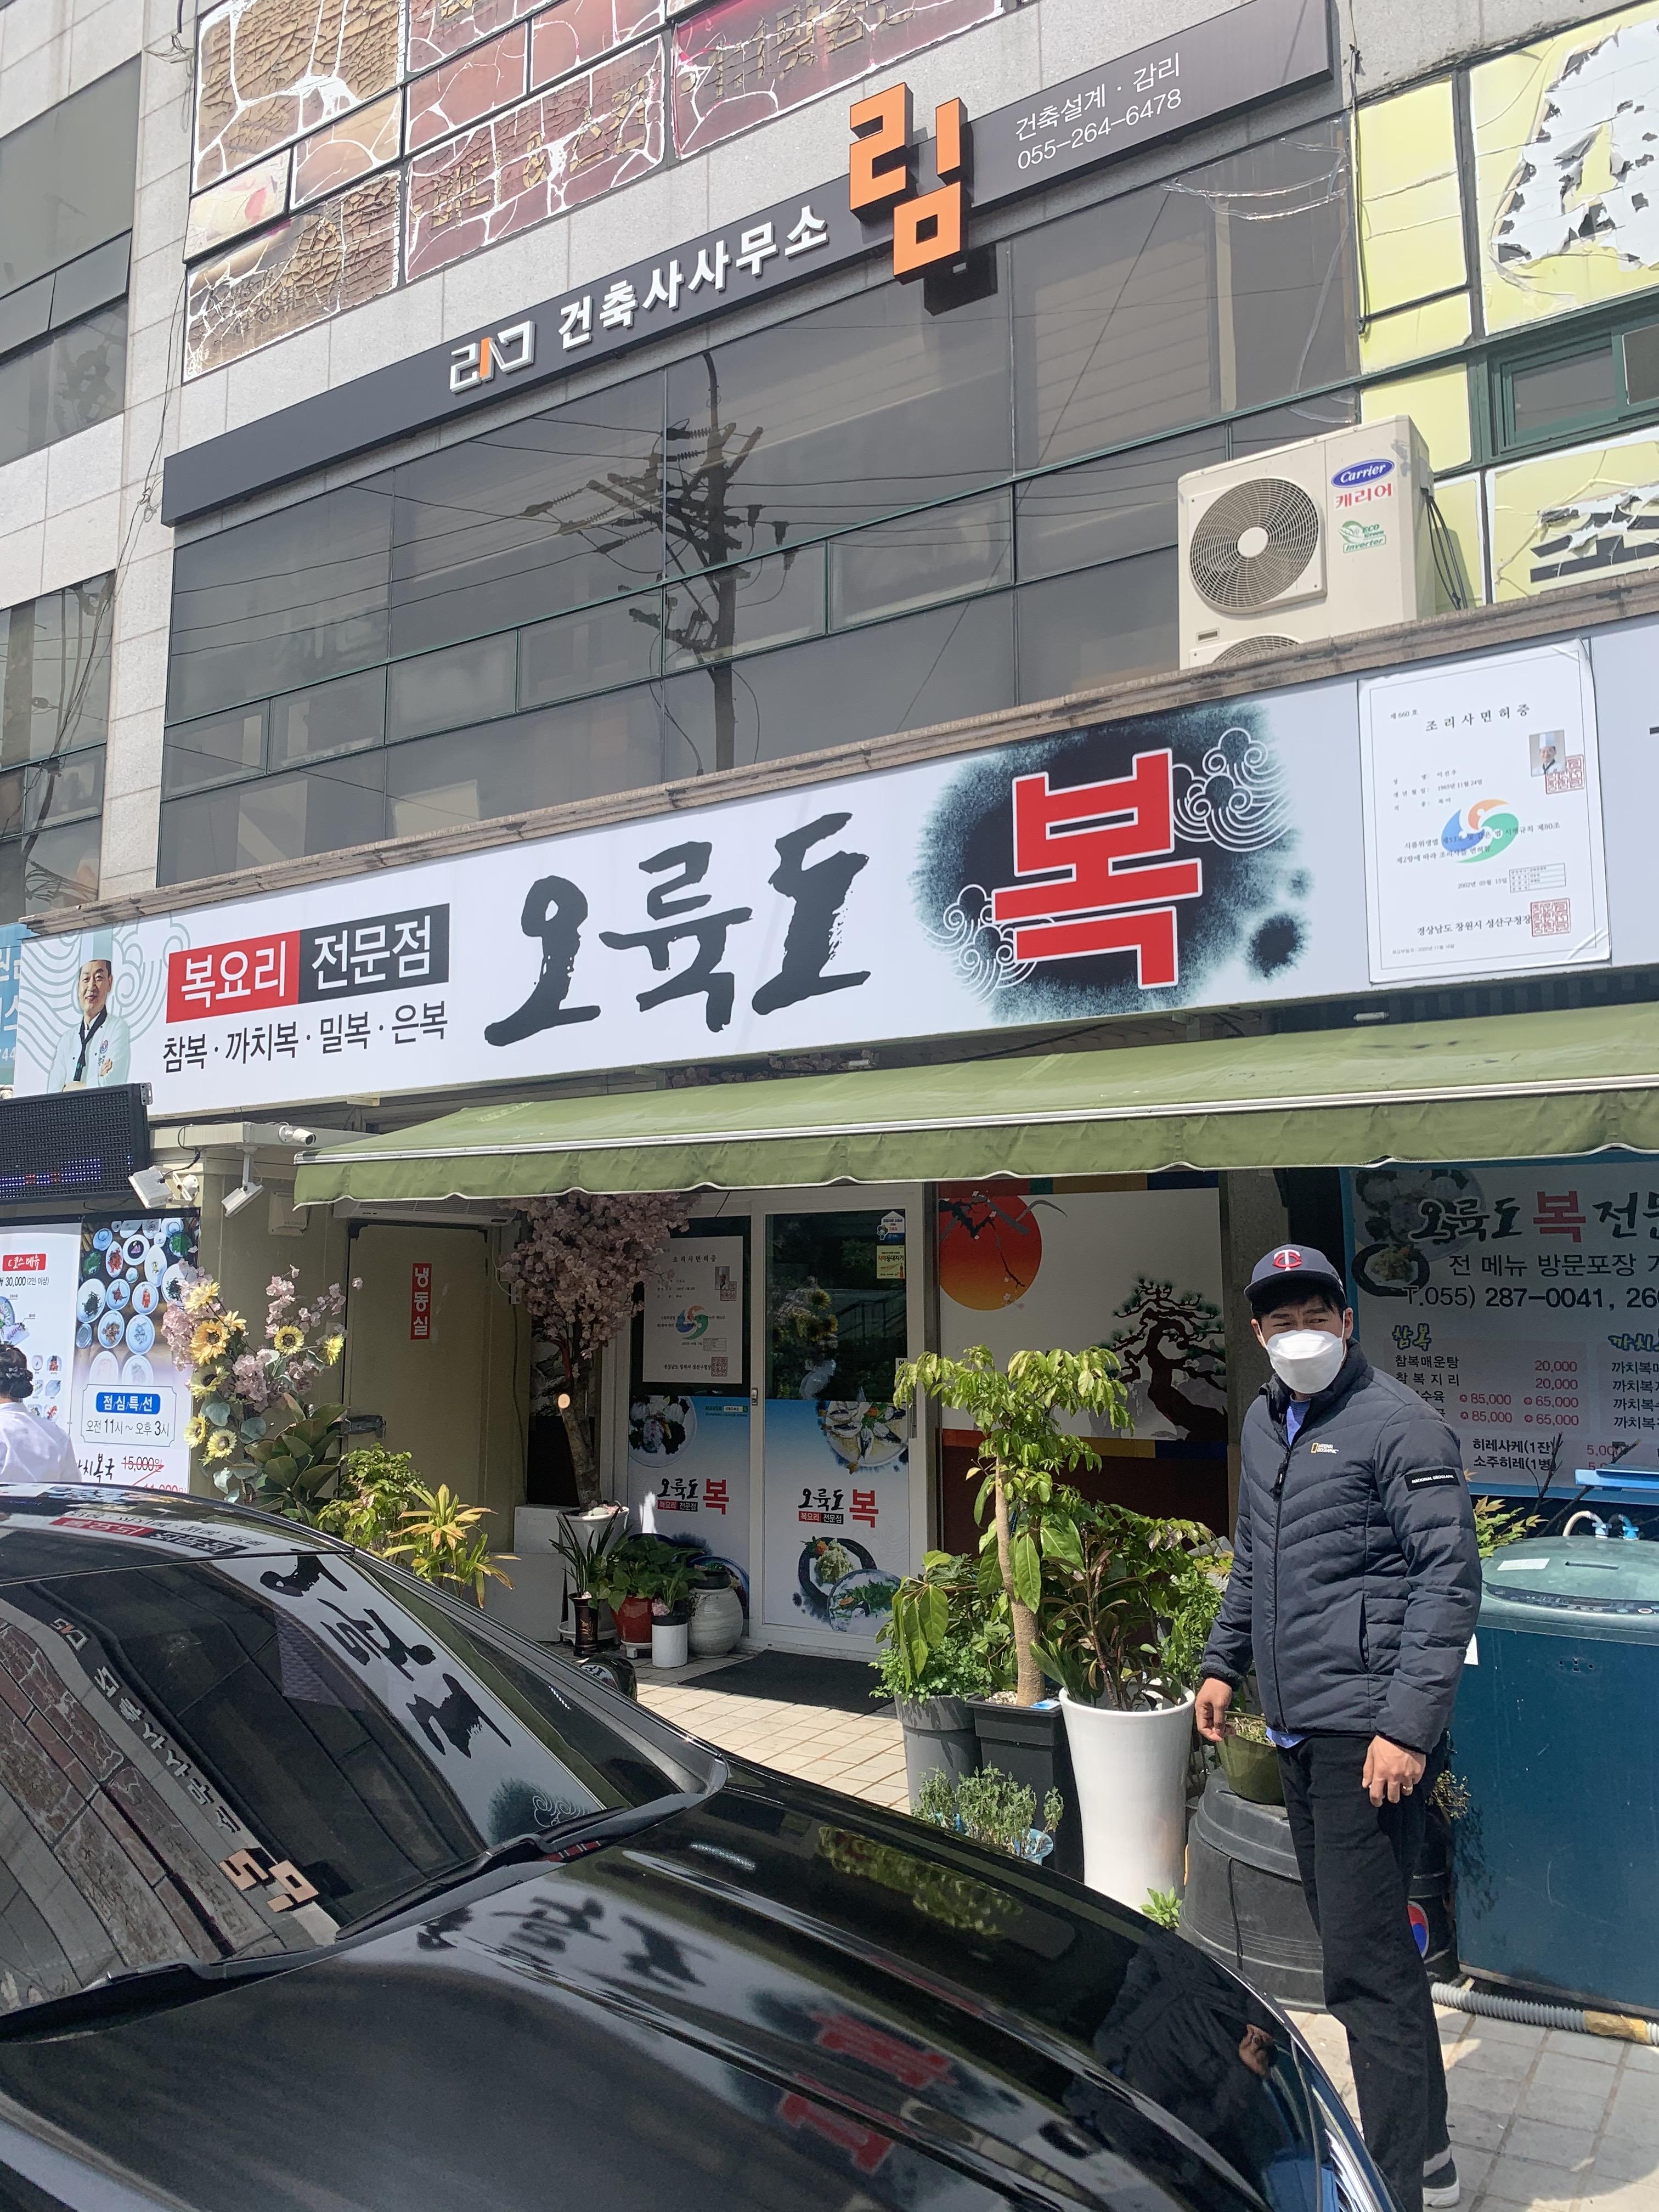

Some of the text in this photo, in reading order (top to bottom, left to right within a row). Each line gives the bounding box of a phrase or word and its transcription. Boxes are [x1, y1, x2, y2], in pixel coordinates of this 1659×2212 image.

[1015, 52, 1180, 142] 건축설계 감리
[1017, 89, 1182, 170] 055-264-6478
[850, 82, 964, 279] 림
[557, 205, 830, 352] 건축사사무소
[1340, 464, 1386, 483] Carrier
[1335, 483, 1392, 509] 캐리어
[1362, 523, 1380, 533] ECO
[1346, 538, 1384, 551] Inverter
[990, 747, 1203, 990] 복
[483, 811, 872, 1048] 오륙도
[180, 915, 431, 1008] 복요리 전문점
[162, 1001, 448, 1074] 참복 까치복 밀복 은복
[1408, 1197, 1523, 1244] 오륙도
[1533, 1190, 1587, 1243] 복
[1449, 1254, 1471, 1277] 전
[1482, 1254, 1528, 1277] 메뉴
[1538, 1253, 1637, 1277] 방문포장
[5, 1277, 26, 1287] 30,000
[1626, 1288, 1659, 1309] 26
[1607, 1329, 1659, 1352] 까치
[1395, 1355, 1577, 1372] 참복매운탕 20,000
[1536, 1378, 1578, 1390] 20,000
[86, 1420, 101, 1434] 오전
[104, 1419, 123, 1435] 11시
[136, 1422, 152, 1436] 오후
[154, 1420, 170, 1437] 3시
[657, 1478, 729, 1515] 오륙도 복
[679, 1502, 696, 1511] 전문점
[798, 1488, 879, 1528] 오륙도 복
[800, 1513, 842, 1523] 복요리 전문점
